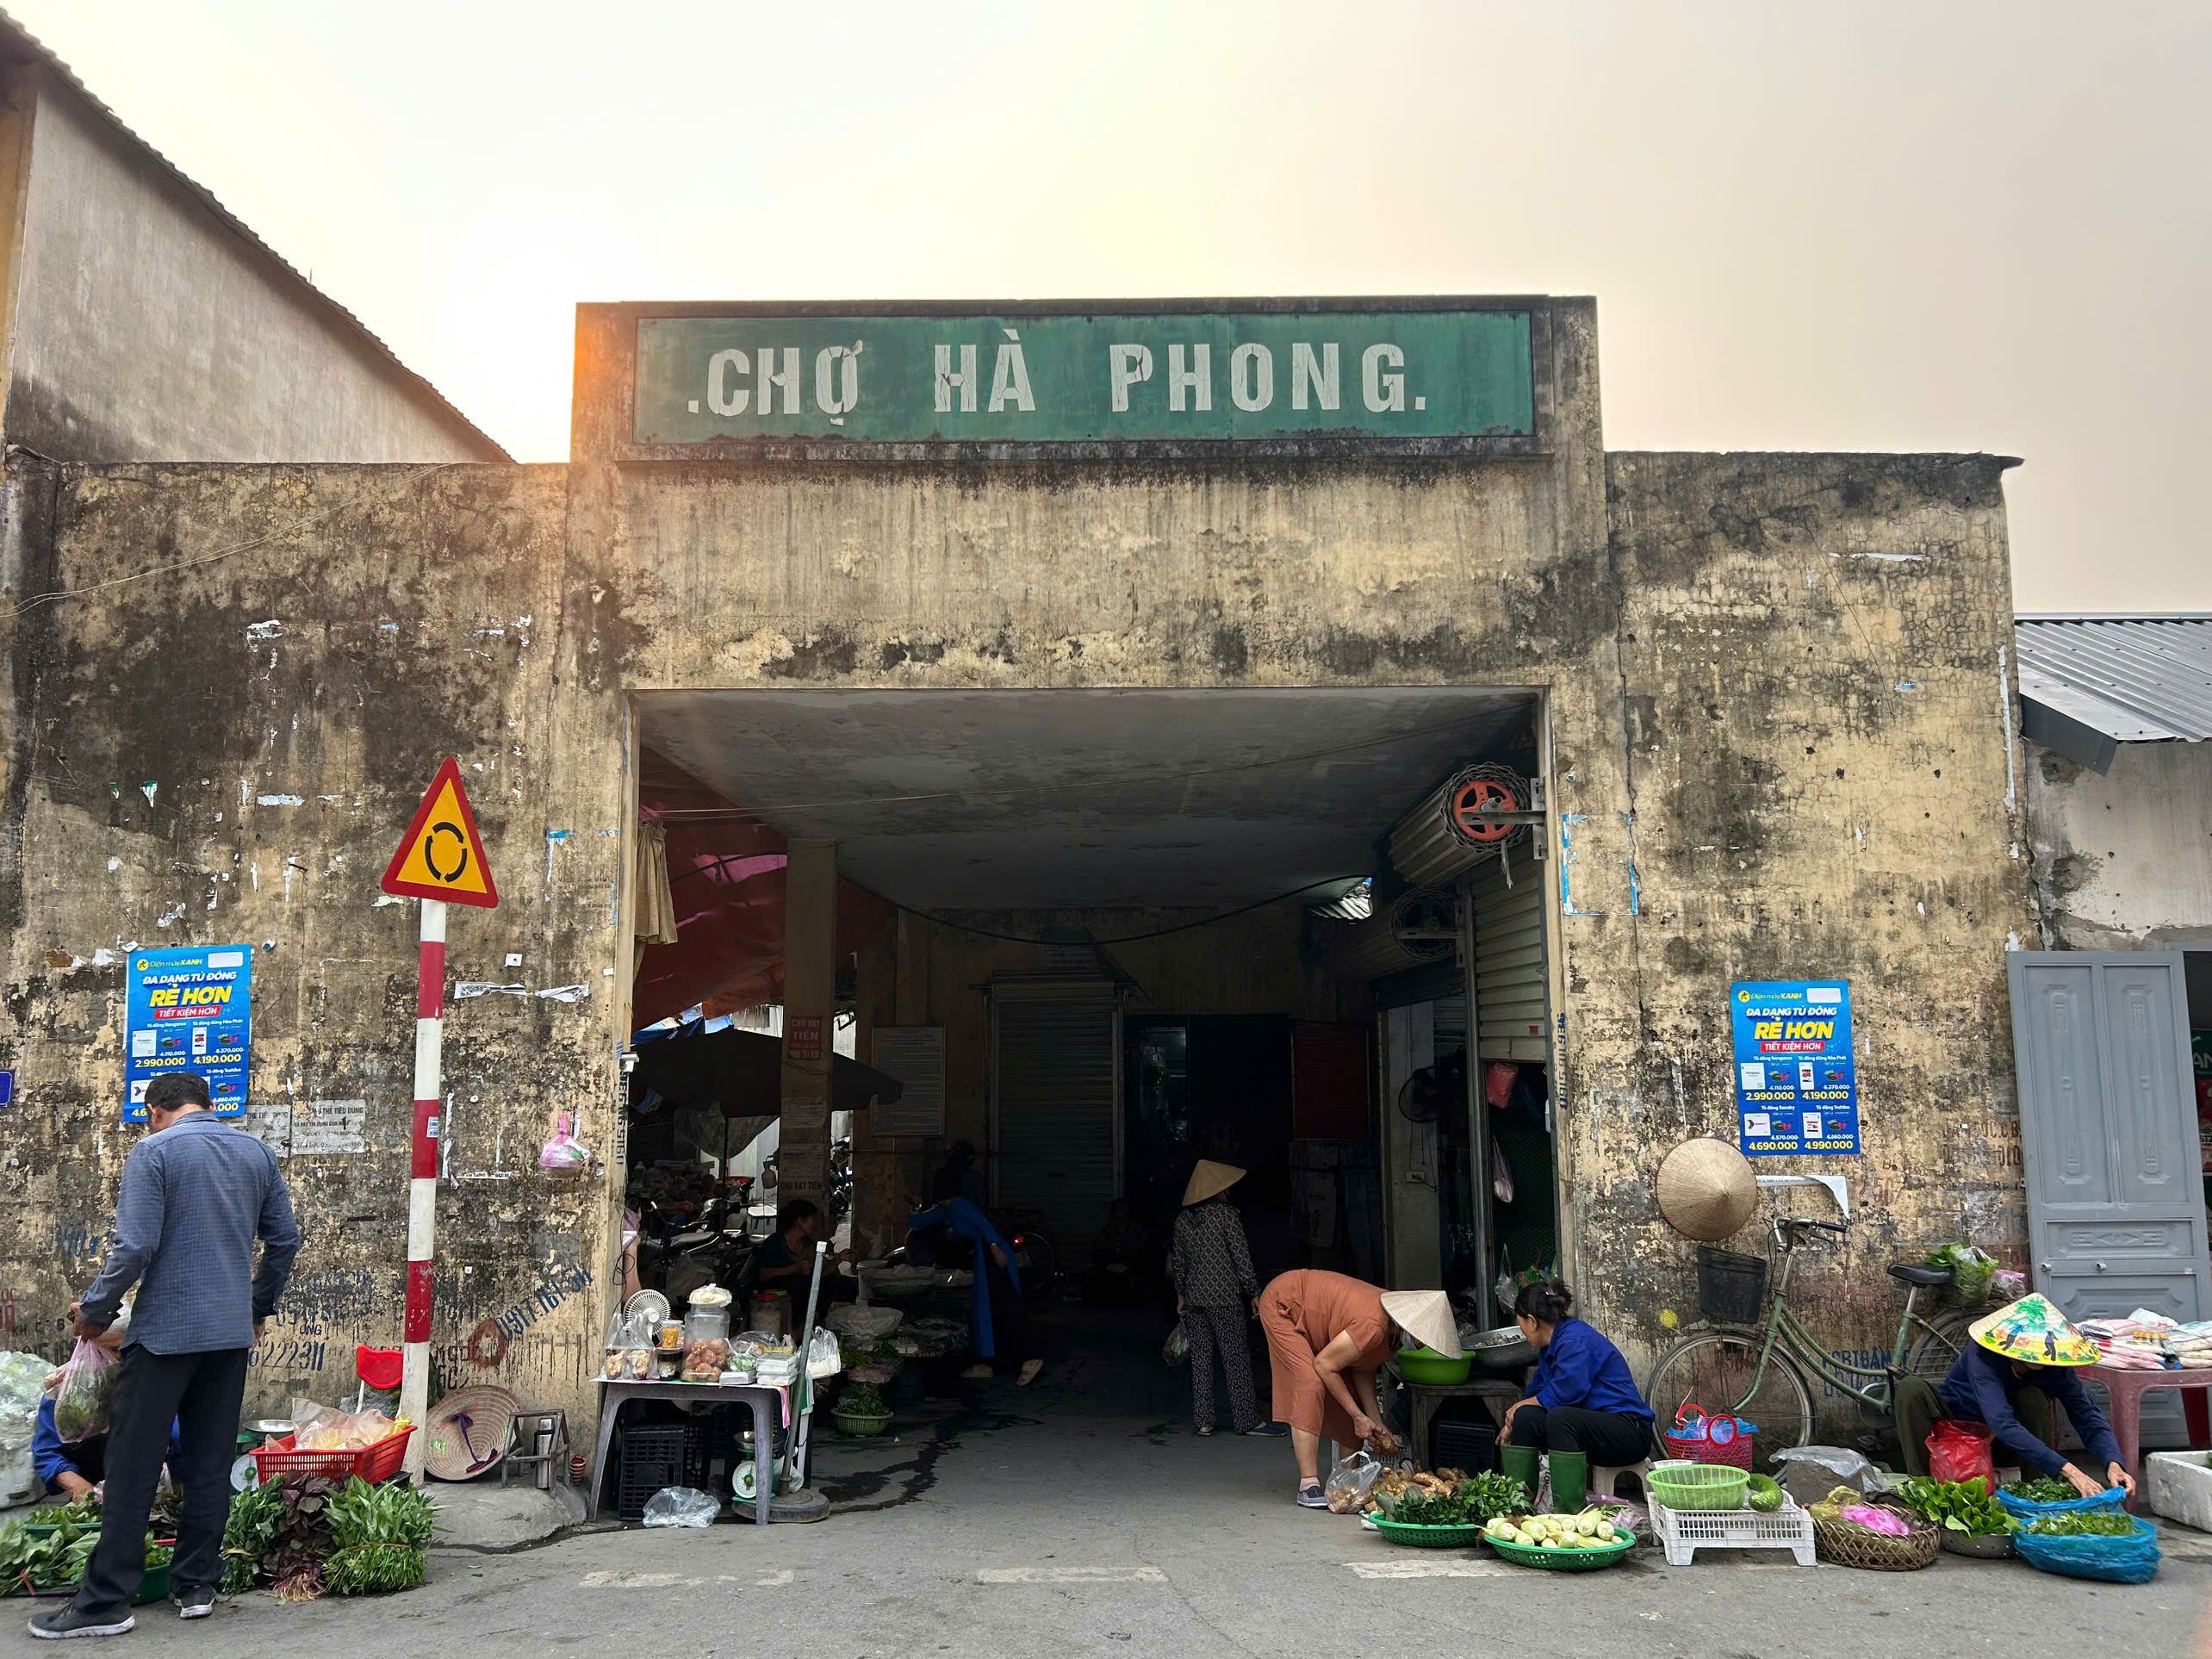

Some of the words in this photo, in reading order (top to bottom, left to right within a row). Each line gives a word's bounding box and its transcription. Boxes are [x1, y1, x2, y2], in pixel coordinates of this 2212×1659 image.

[934, 329, 1035, 413] HÀ
[142, 976, 158, 985] ĐA
[159, 973, 190, 987] DẠNG
[190, 972, 205, 982] TỦ
[206, 971, 237, 981] ĐÔNG
[149, 984, 180, 1008] RẺ
[181, 985, 233, 1006] HƠN
[158, 1008, 176, 1017] TIẾT
[177, 1009, 197, 1018] KIỆM
[198, 1007, 217, 1016] HƠN
[1746, 1008, 1760, 1016] ĐA
[1762, 1008, 1792, 1019] DẠNG
[1793, 1005, 1805, 1016] TỦ
[1807, 1005, 1837, 1016] ĐÔNG
[807, 1019, 820, 1028] VAY
[1754, 1016, 1784, 1040] RẺ
[1785, 1021, 1834, 1040] HƠN
[1764, 1041, 1780, 1050] TIẾT
[1781, 1042, 1802, 1052] KIỆM
[1803, 1041, 1821, 1050] HƠN
[134, 1057, 186, 1068] 2.990.000
[193, 1053, 241, 1065] 4.190.000
[1745, 1091, 1795, 1101] 2.990.000
[1802, 1090, 1849, 1100] 4.190.000
[1749, 1141, 1798, 1151] 4.690.000
[1804, 1140, 1854, 1150] 4.990.000
